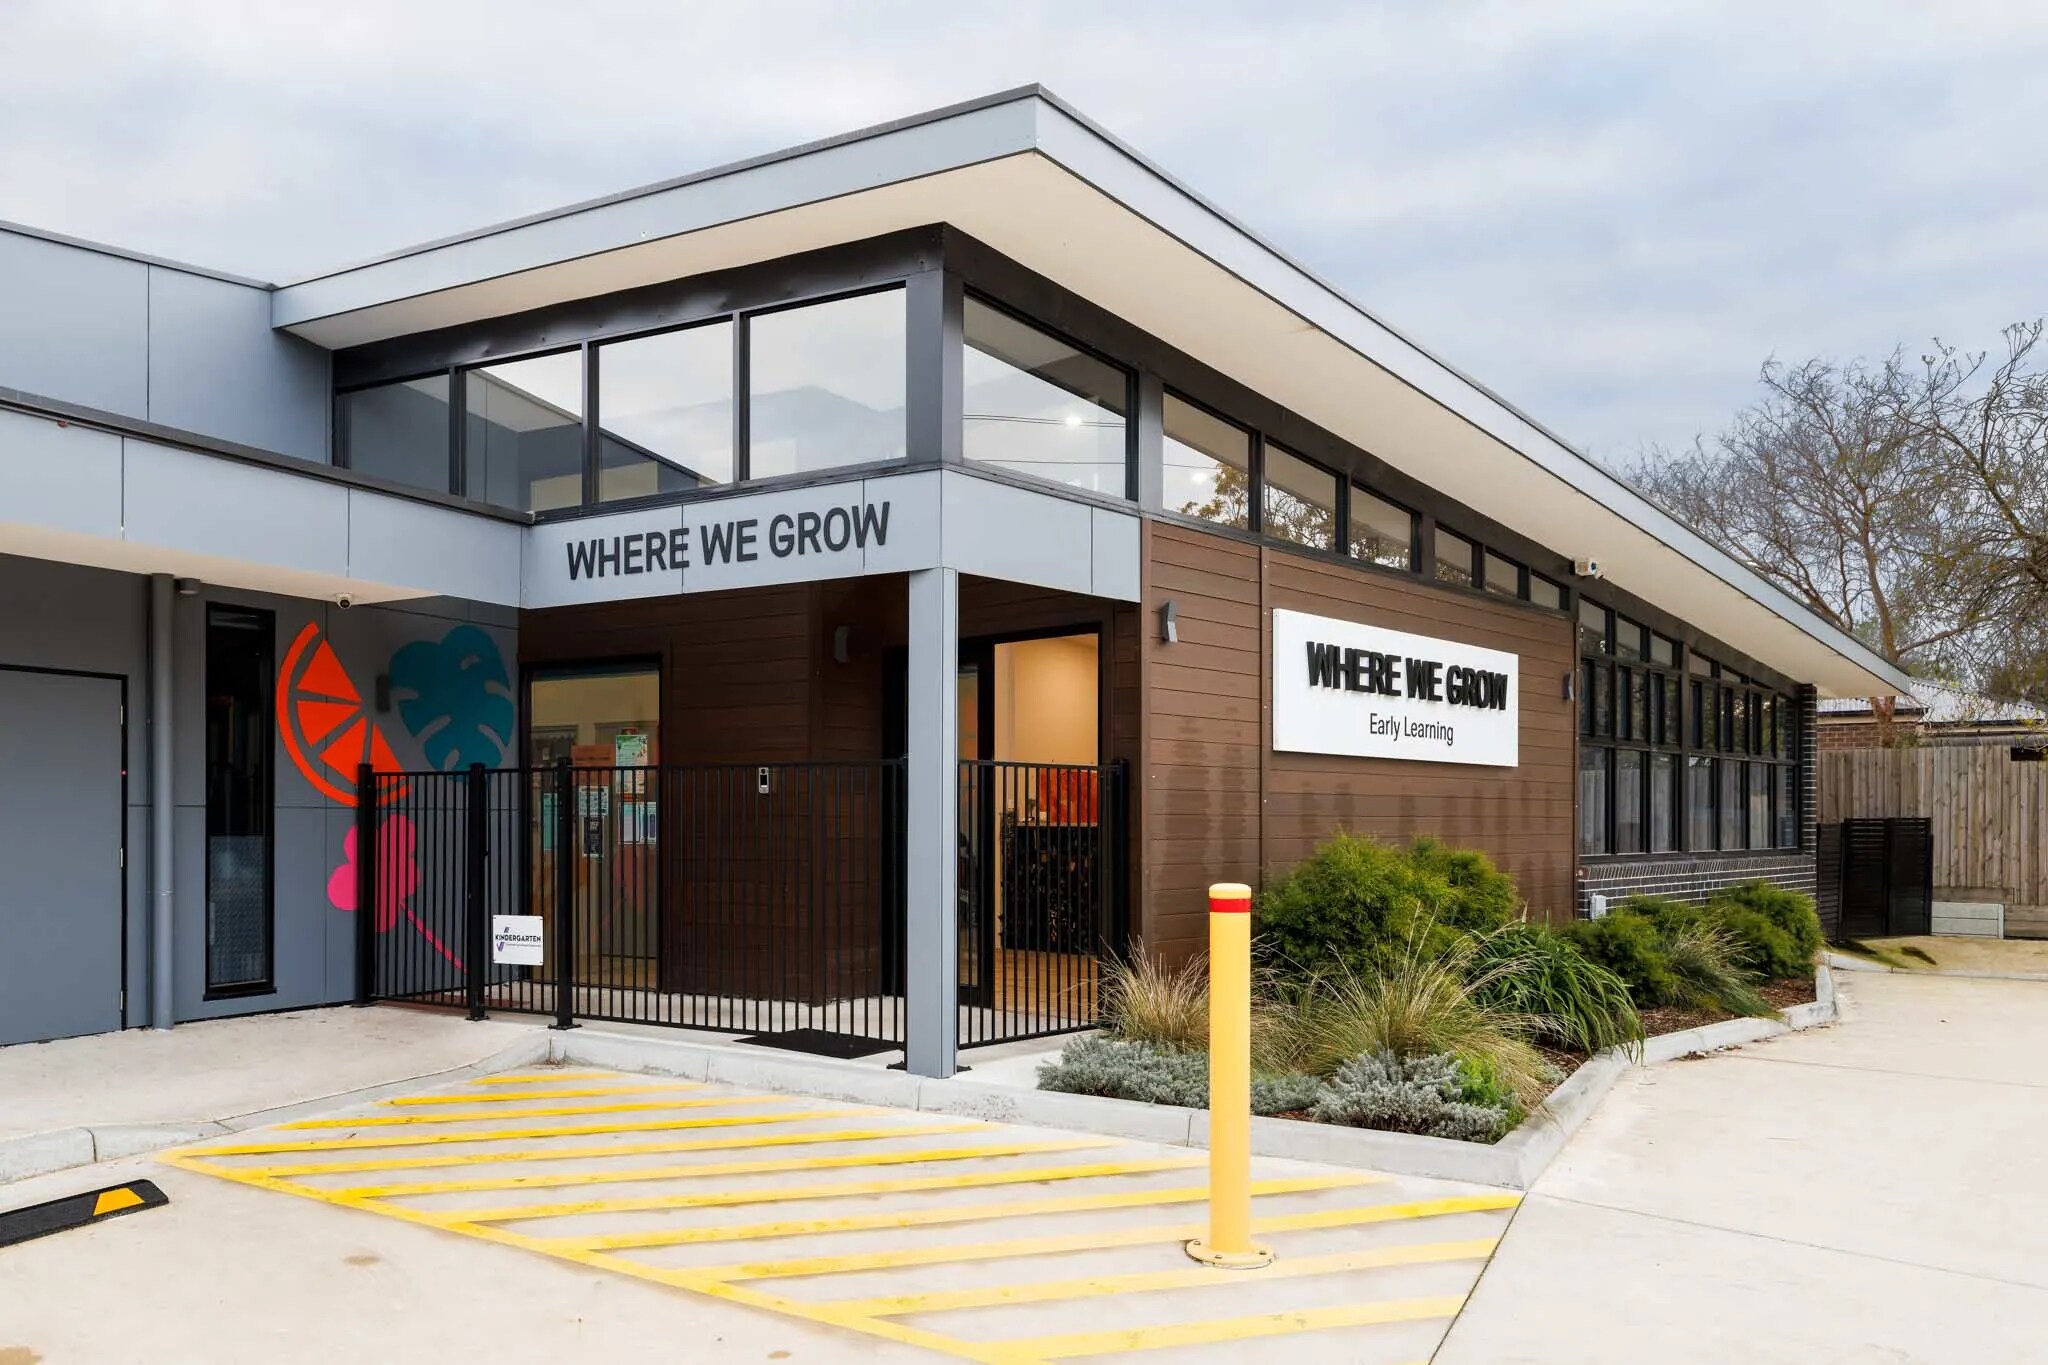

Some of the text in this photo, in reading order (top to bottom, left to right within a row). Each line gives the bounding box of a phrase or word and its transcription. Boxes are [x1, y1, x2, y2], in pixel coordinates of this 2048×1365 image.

[567, 501, 890, 581] WHERE WE GROW
[1306, 641, 1508, 711] WHERE WE GROW
[1369, 713, 1454, 746] Early Learning
[495, 934, 541, 942] KINDERGARTEN
